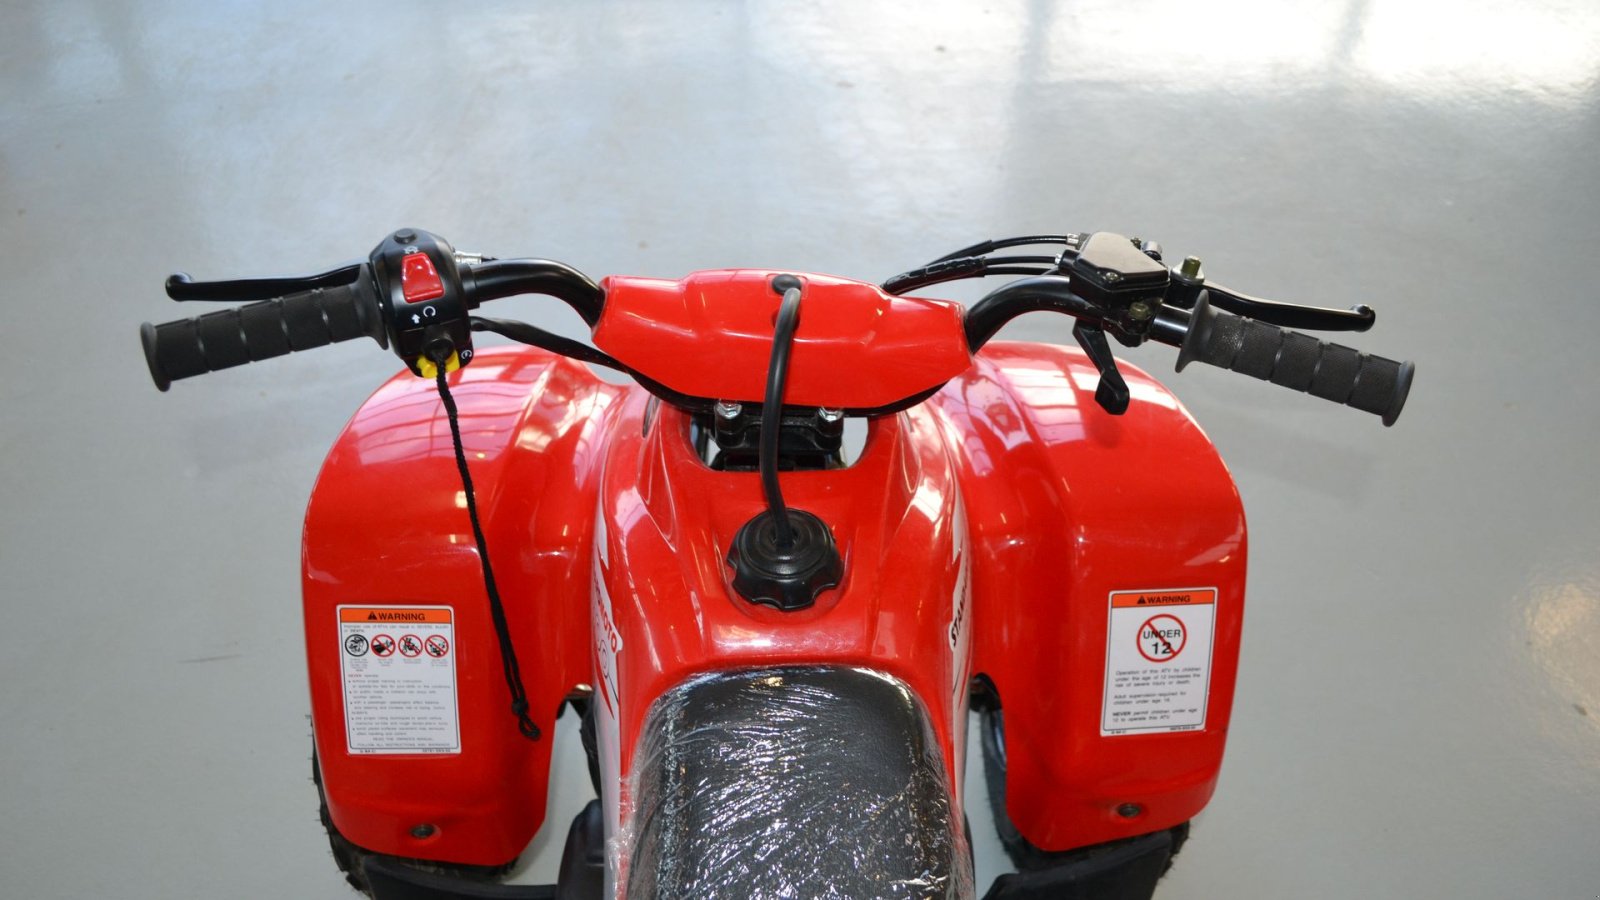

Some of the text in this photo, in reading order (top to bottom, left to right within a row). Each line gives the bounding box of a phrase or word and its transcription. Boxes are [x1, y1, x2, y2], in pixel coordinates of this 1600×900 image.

[1147, 594, 1191, 604] WARNING
[378, 612, 425, 621] WARNING
[1143, 629, 1181, 639] UNDER
[1151, 641, 1173, 655] 12
